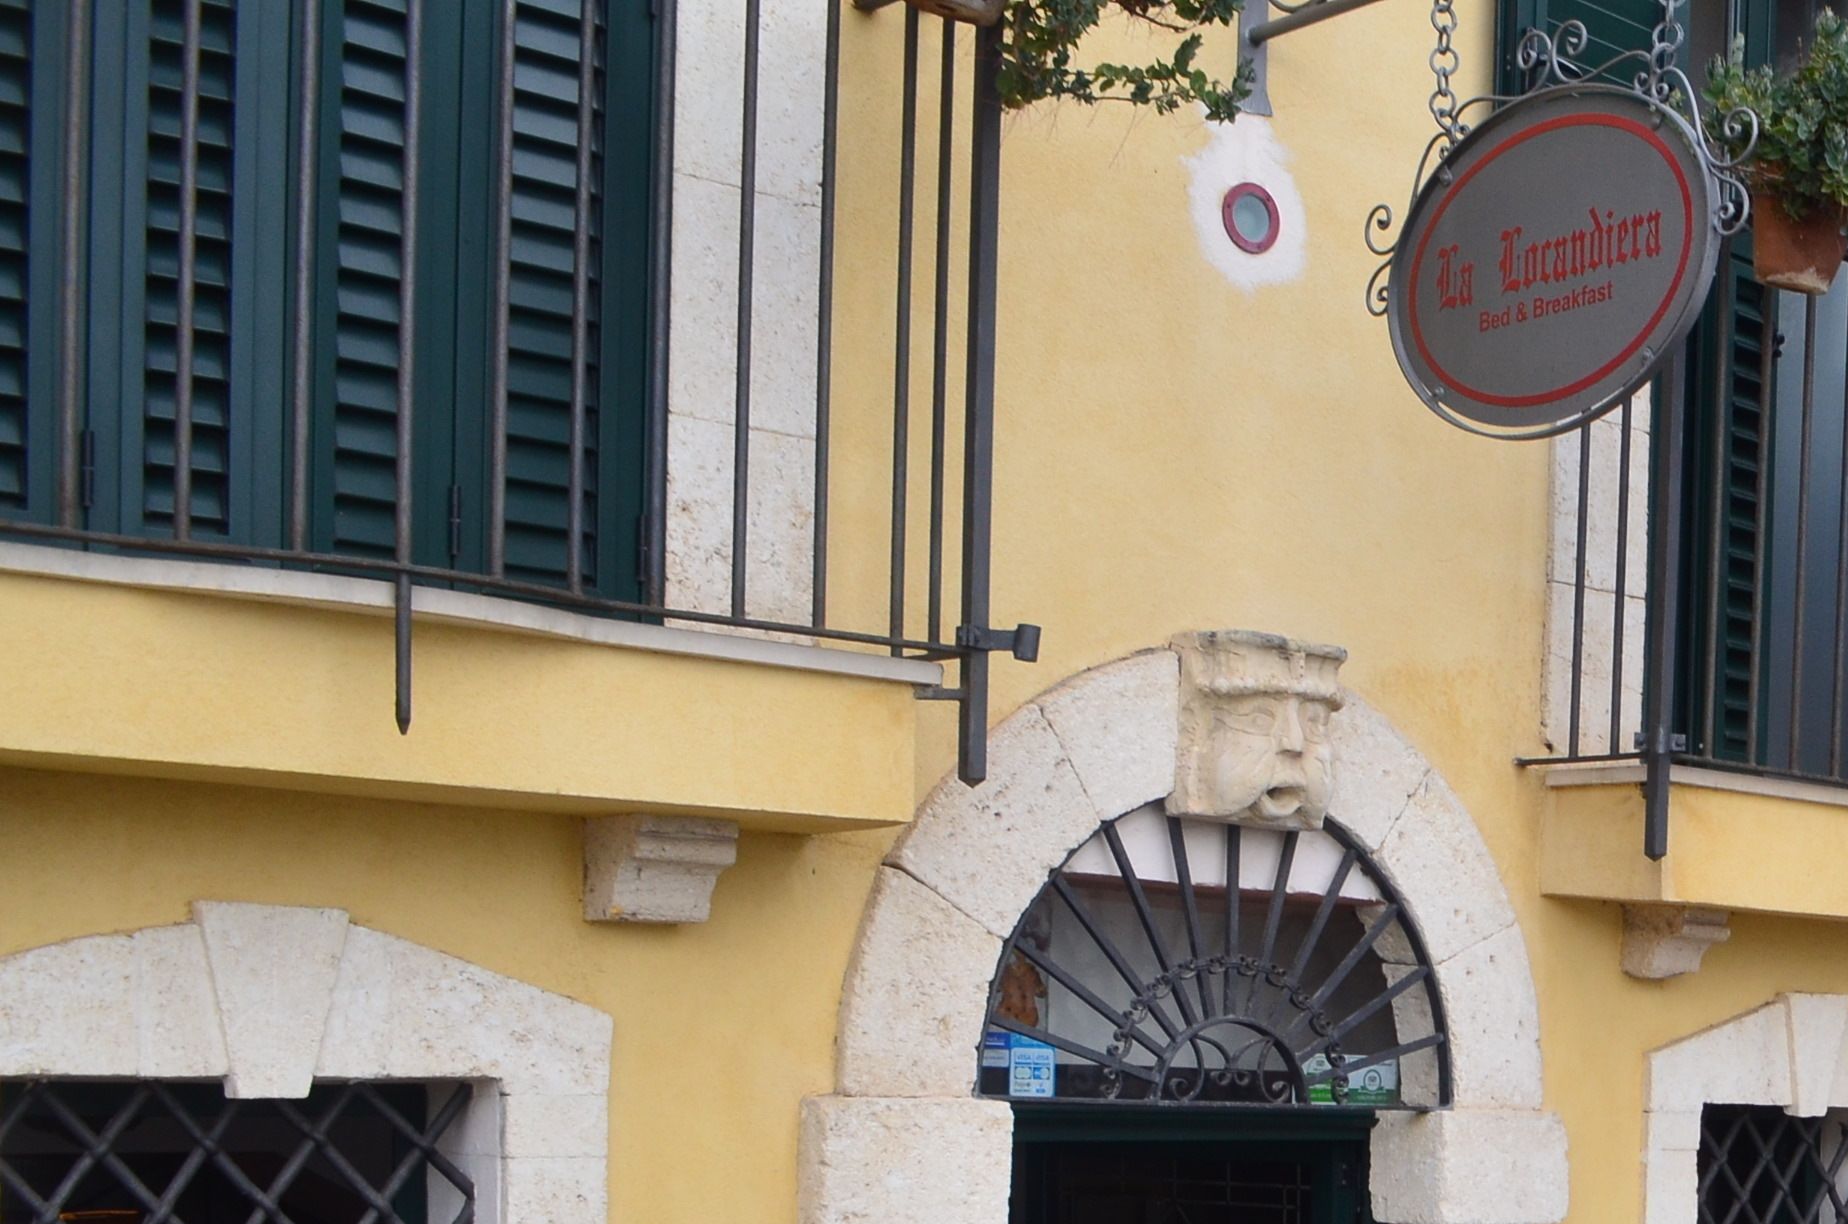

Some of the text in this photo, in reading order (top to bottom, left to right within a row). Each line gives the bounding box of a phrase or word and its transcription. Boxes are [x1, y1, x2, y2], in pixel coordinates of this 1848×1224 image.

[1436, 206, 1664, 311] La Locandiera
[1480, 280, 1613, 333] Bed & Breakfast
